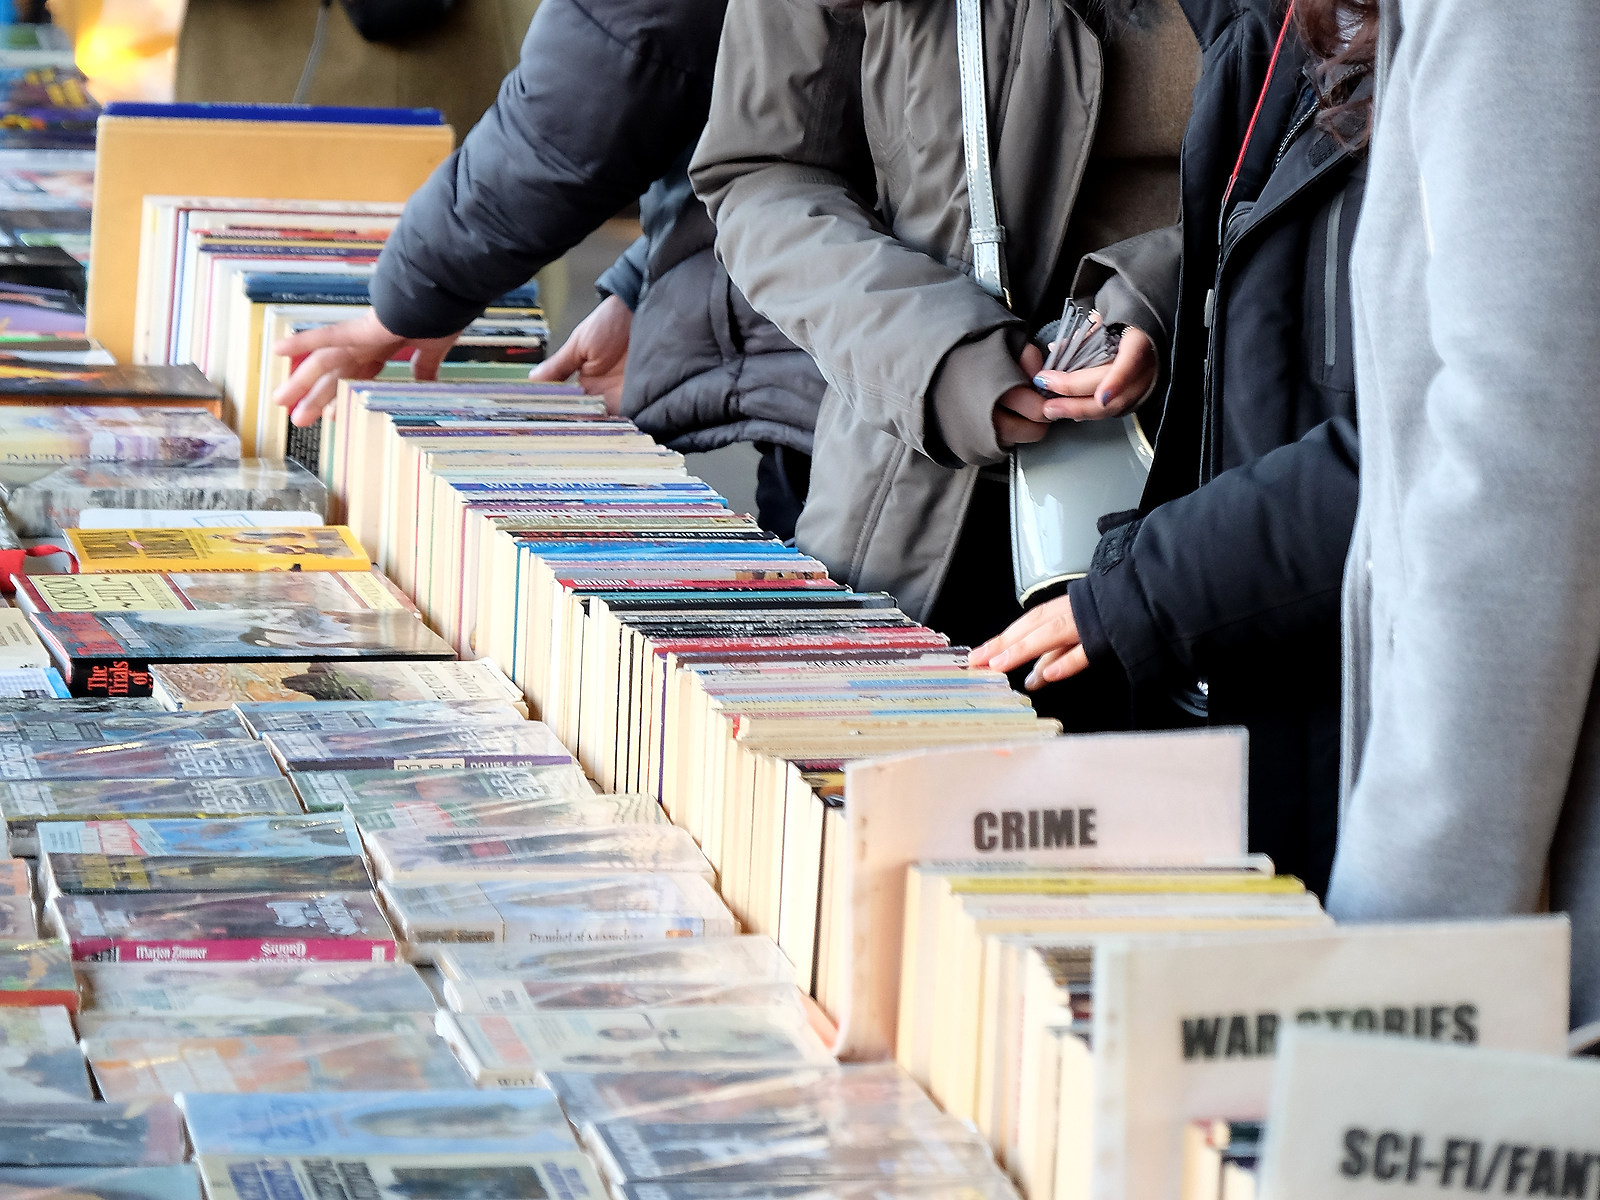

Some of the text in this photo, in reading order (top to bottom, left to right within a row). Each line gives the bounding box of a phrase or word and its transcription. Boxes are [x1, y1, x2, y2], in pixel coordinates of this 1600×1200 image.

[87, 665, 108, 691] The
[108, 660, 129, 696] Trials
[129, 670, 148, 686] of
[973, 808, 1098, 853] CRIME
[136, 946, 170, 959] Marion
[171, 946, 207, 959] Zimmer
[1180, 1011, 1278, 1062] WAR
